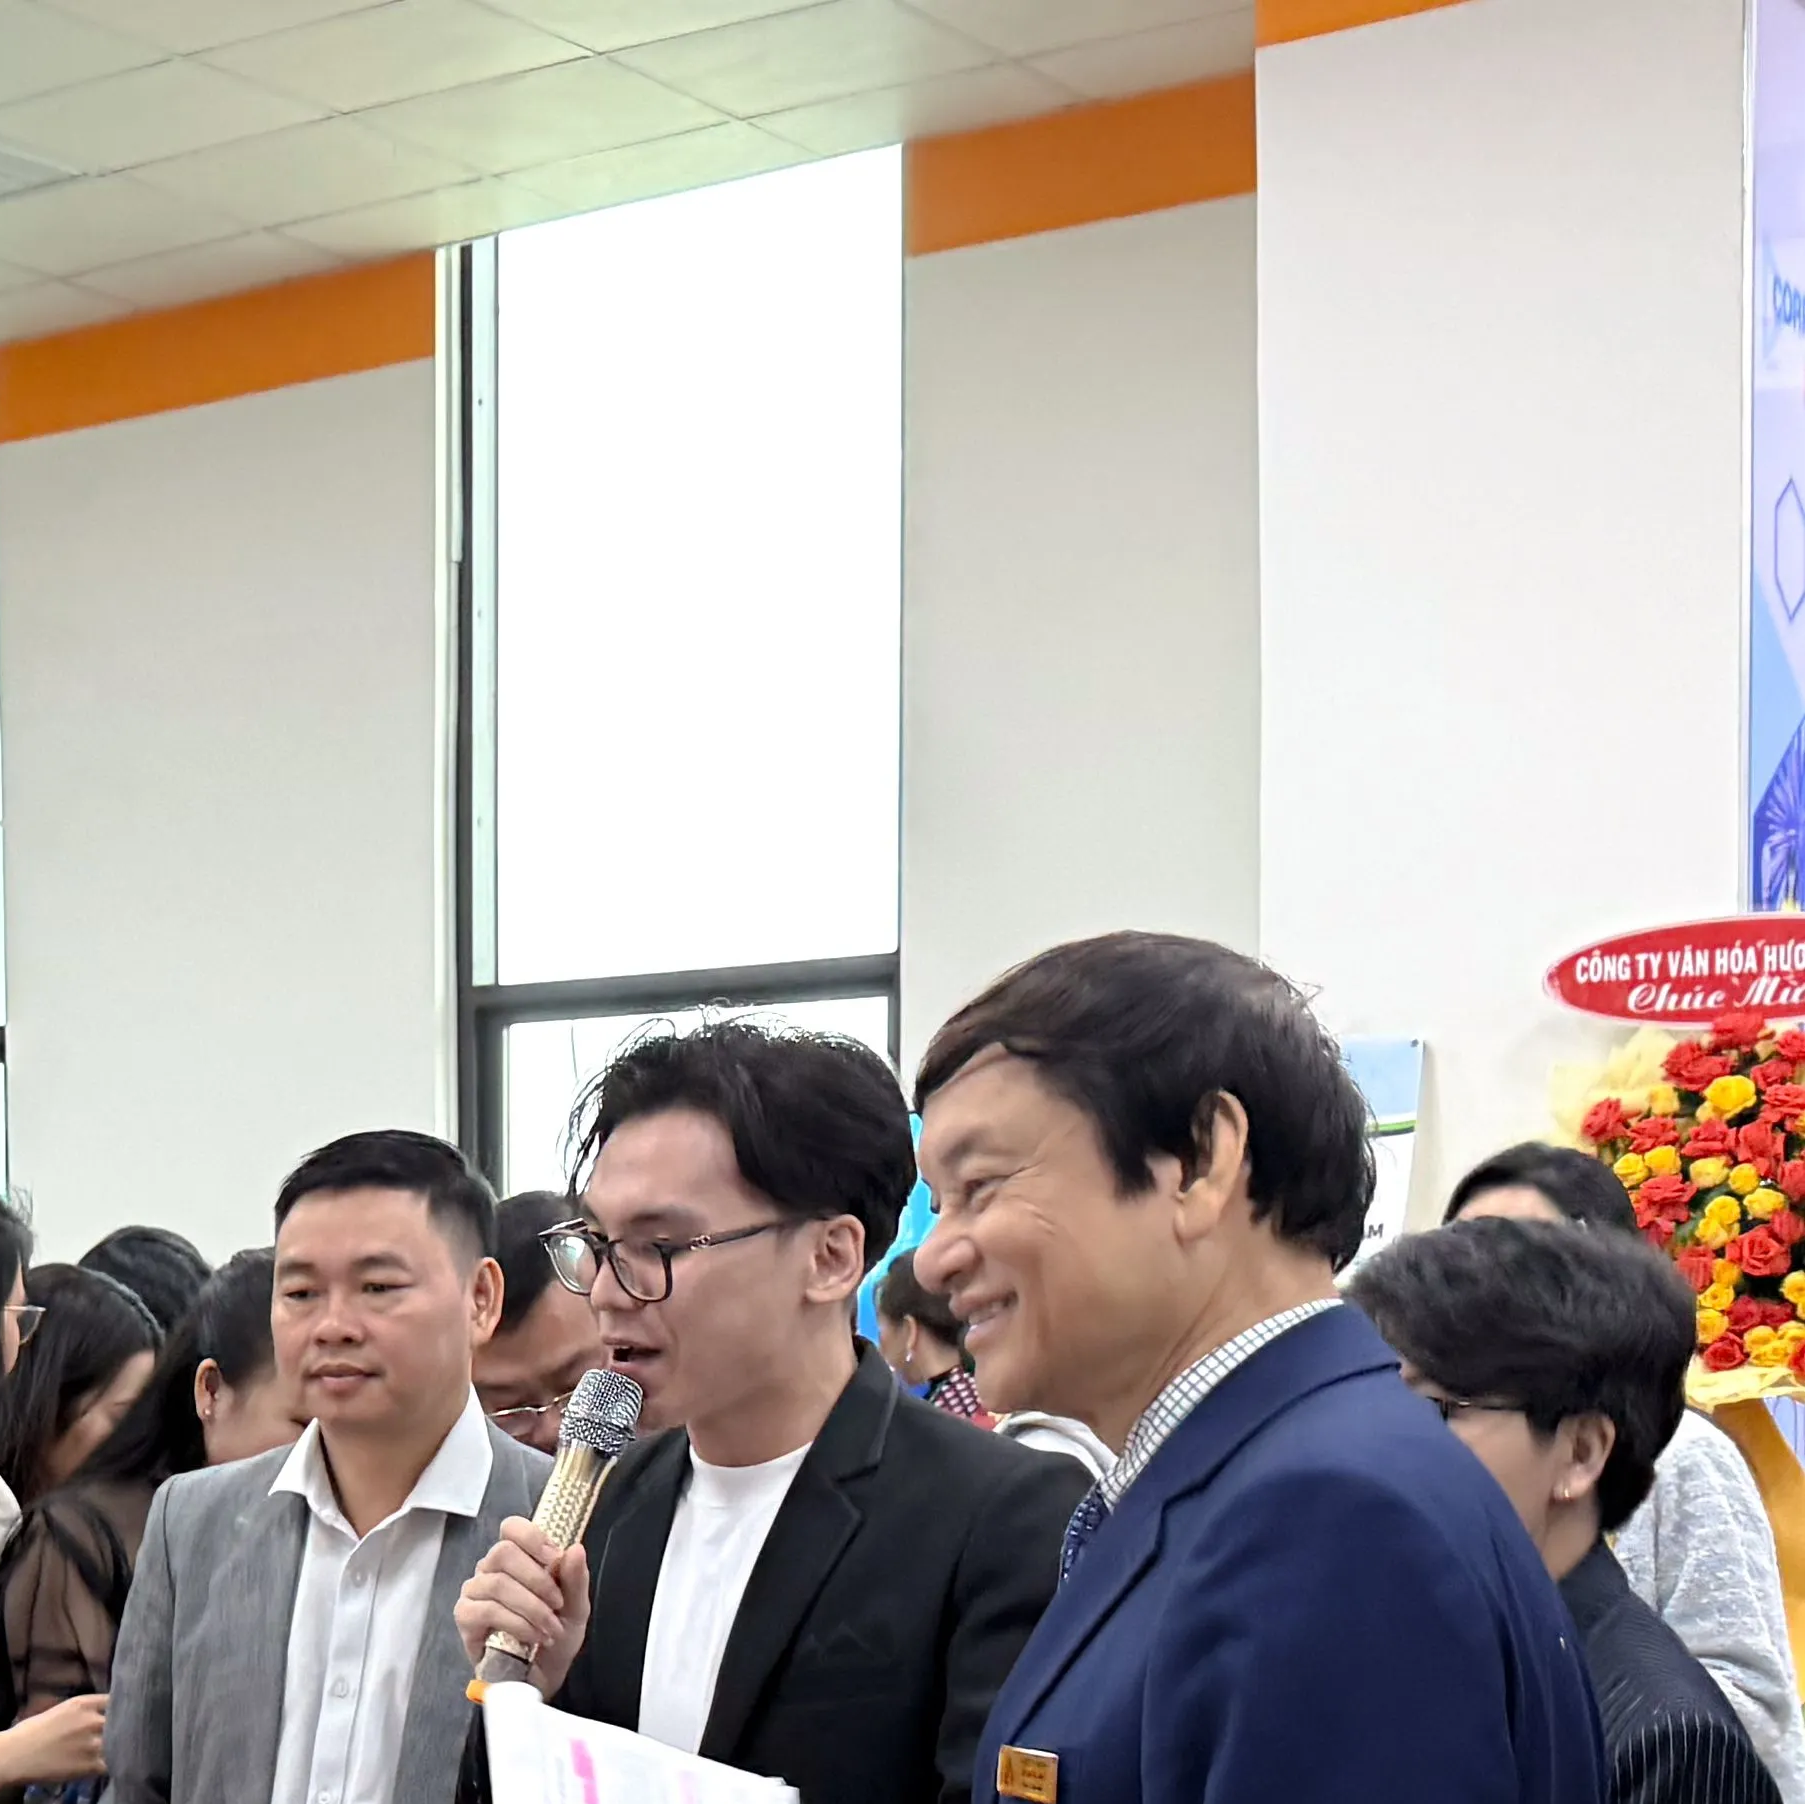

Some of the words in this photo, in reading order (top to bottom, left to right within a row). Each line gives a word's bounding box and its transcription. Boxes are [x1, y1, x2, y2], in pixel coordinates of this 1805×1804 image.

[1773, 274, 1805, 337] COR
[1575, 950, 1630, 984] CÔNG
[1636, 952, 1662, 980] TY
[1668, 944, 1709, 978] VĂN
[1715, 939, 1758, 975] HÓA
[1628, 982, 1726, 1014] Chúc
